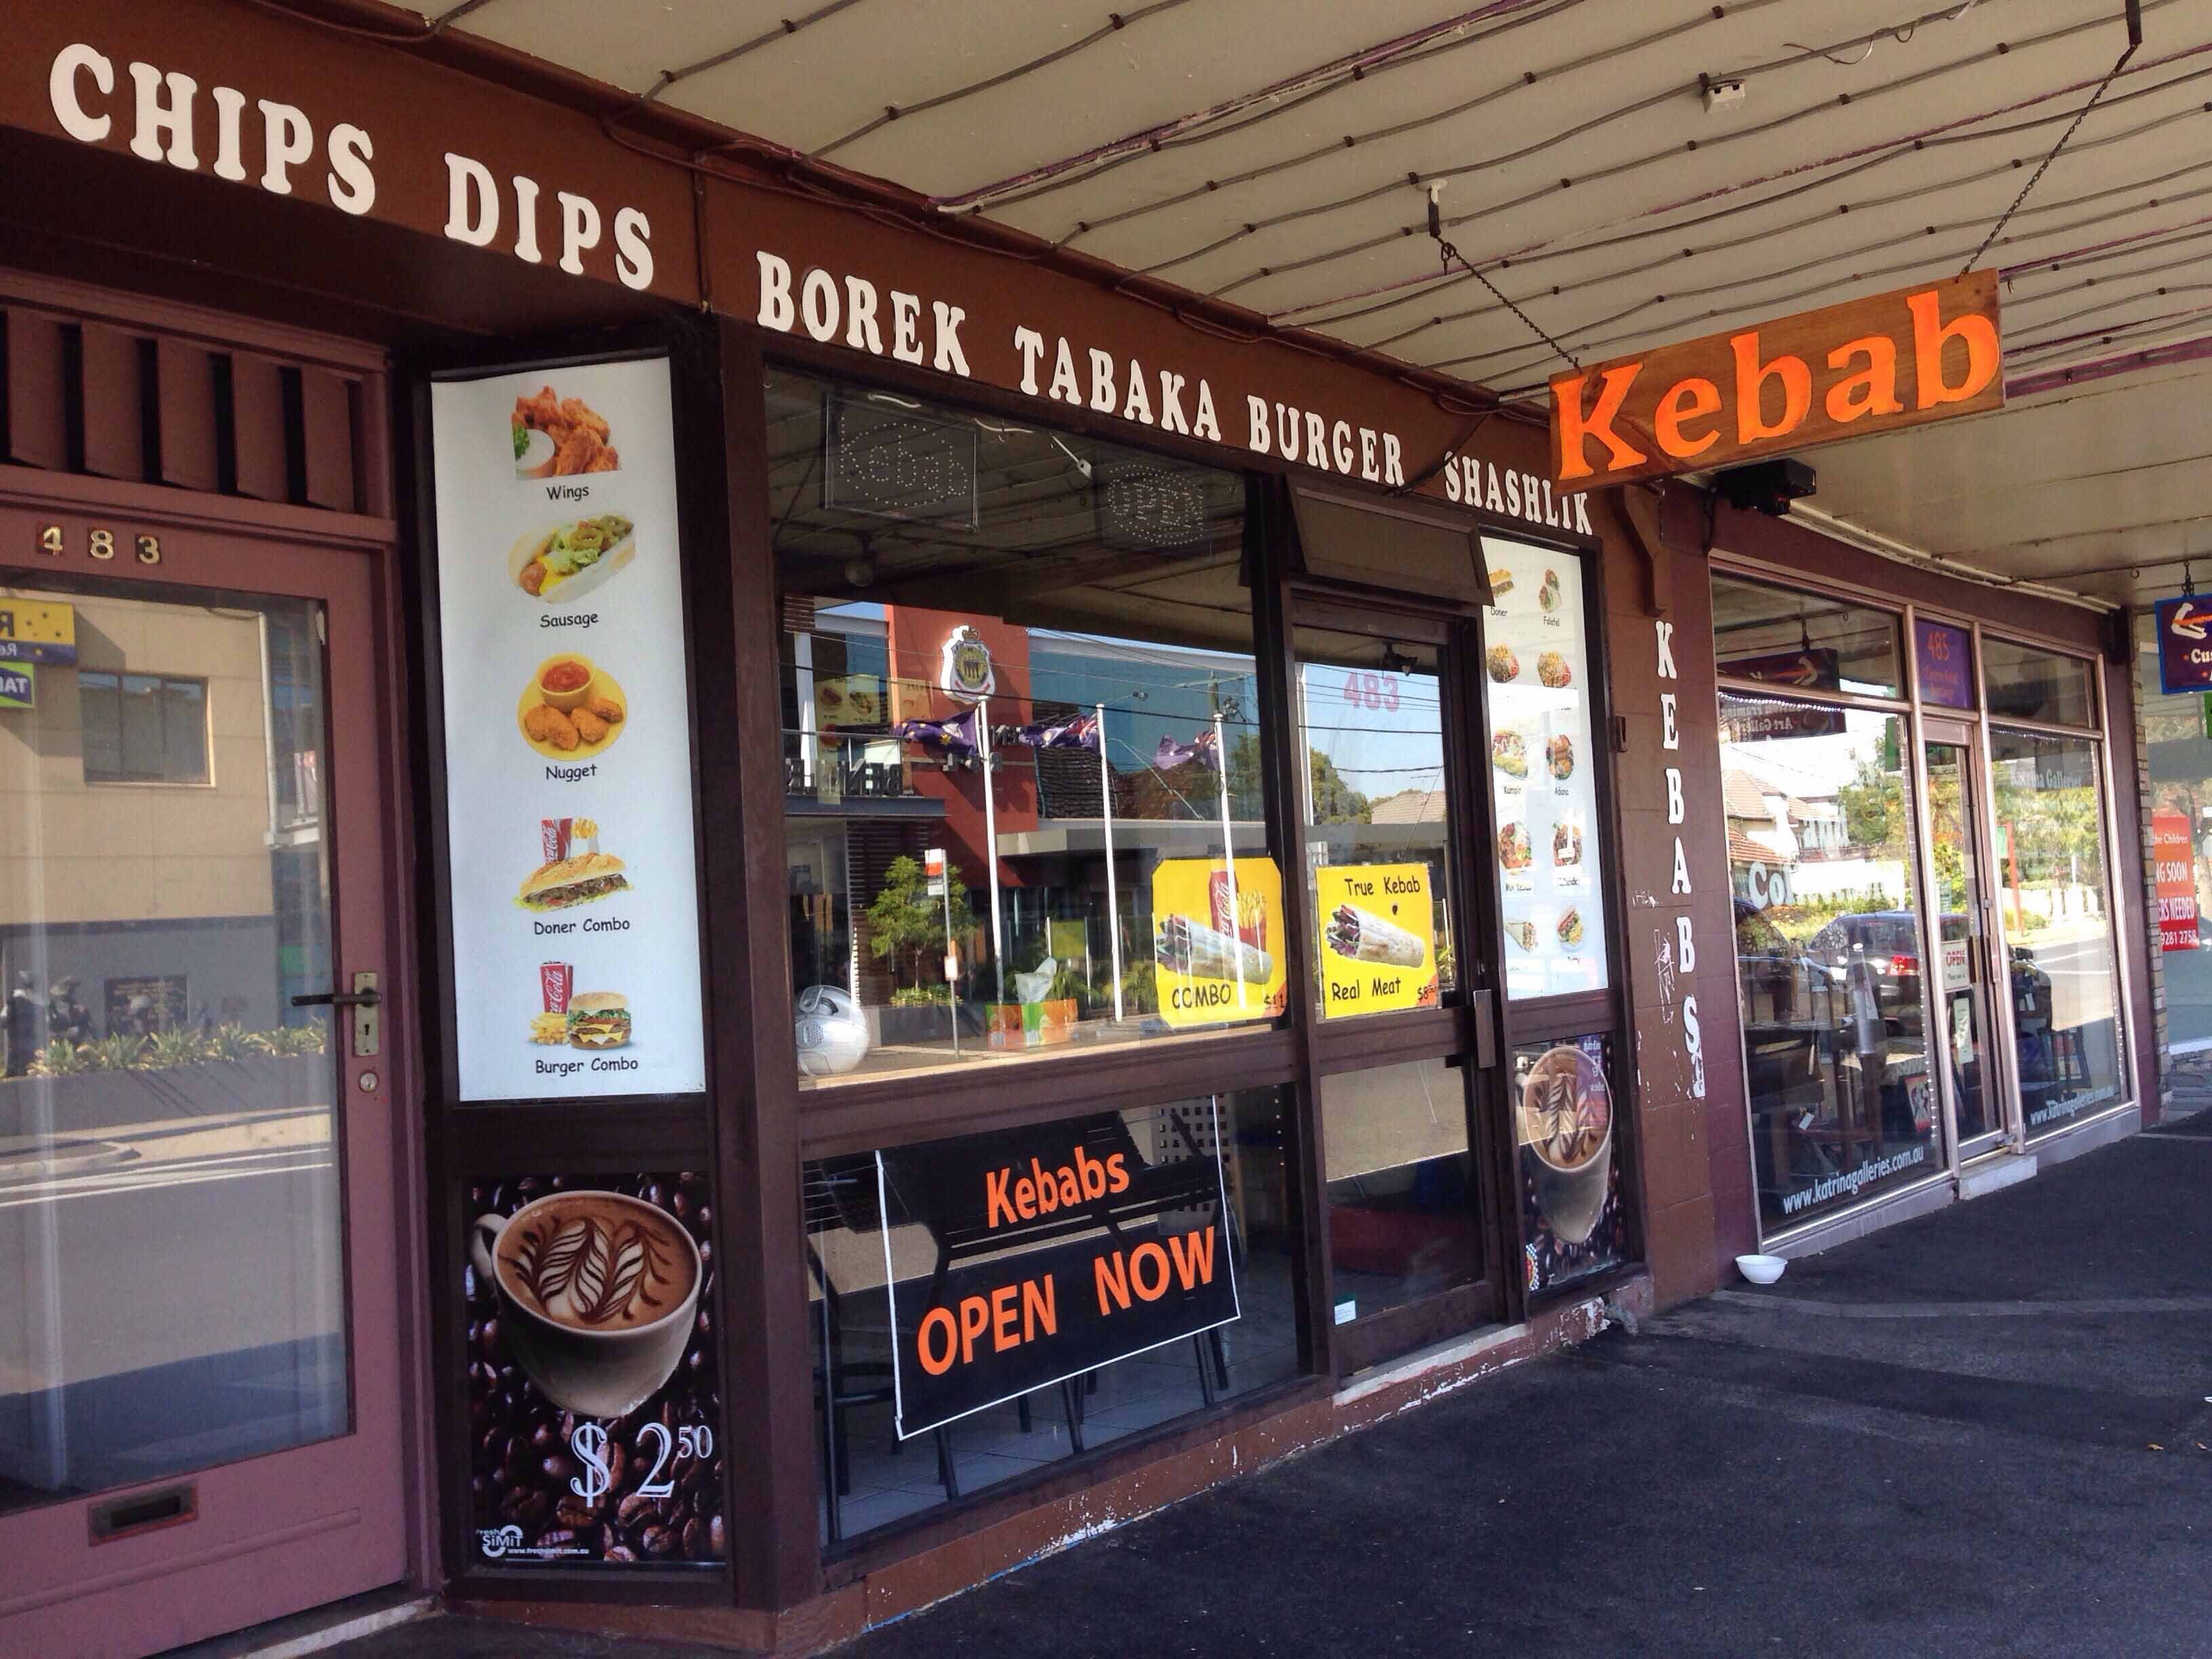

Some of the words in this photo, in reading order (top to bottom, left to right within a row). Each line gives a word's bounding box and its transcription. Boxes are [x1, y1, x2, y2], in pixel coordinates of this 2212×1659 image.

[49, 43, 376, 216] CHIPS
[443, 152, 654, 290] DIPS
[756, 251, 970, 377] BOREK
[1015, 325, 1221, 442] TABAKA
[1248, 394, 1405, 486] BURGER
[1444, 451, 1593, 536] SHASHLIK
[1552, 289, 2000, 480] Kebab
[546, 485, 590, 501] Wings
[42, 527, 161, 565] 483
[539, 611, 599, 629] Sausage
[2190, 649, 2212, 663] Cu
[1344, 672, 1399, 713] 483
[546, 764, 597, 782] Nugget
[2167, 861, 2188, 882] SOON
[1345, 878, 1374, 896] True
[1384, 876, 1420, 894] Kebab
[2170, 896, 2195, 920] NEEDED
[534, 920, 576, 936] Doner
[582, 917, 630, 932] Combo
[1172, 983, 1231, 1010] COMBO
[1332, 979, 1360, 1001] Real
[1372, 977, 1401, 998] Meat
[535, 1060, 584, 1077] Burger
[591, 1057, 638, 1072] Combo
[986, 1146, 1130, 1228] Kebabs
[1783, 1145, 1924, 1214] www.katrinagalleries.com.au
[917, 1274, 1058, 1375] OPEN
[1094, 1225, 1215, 1316] NOW
